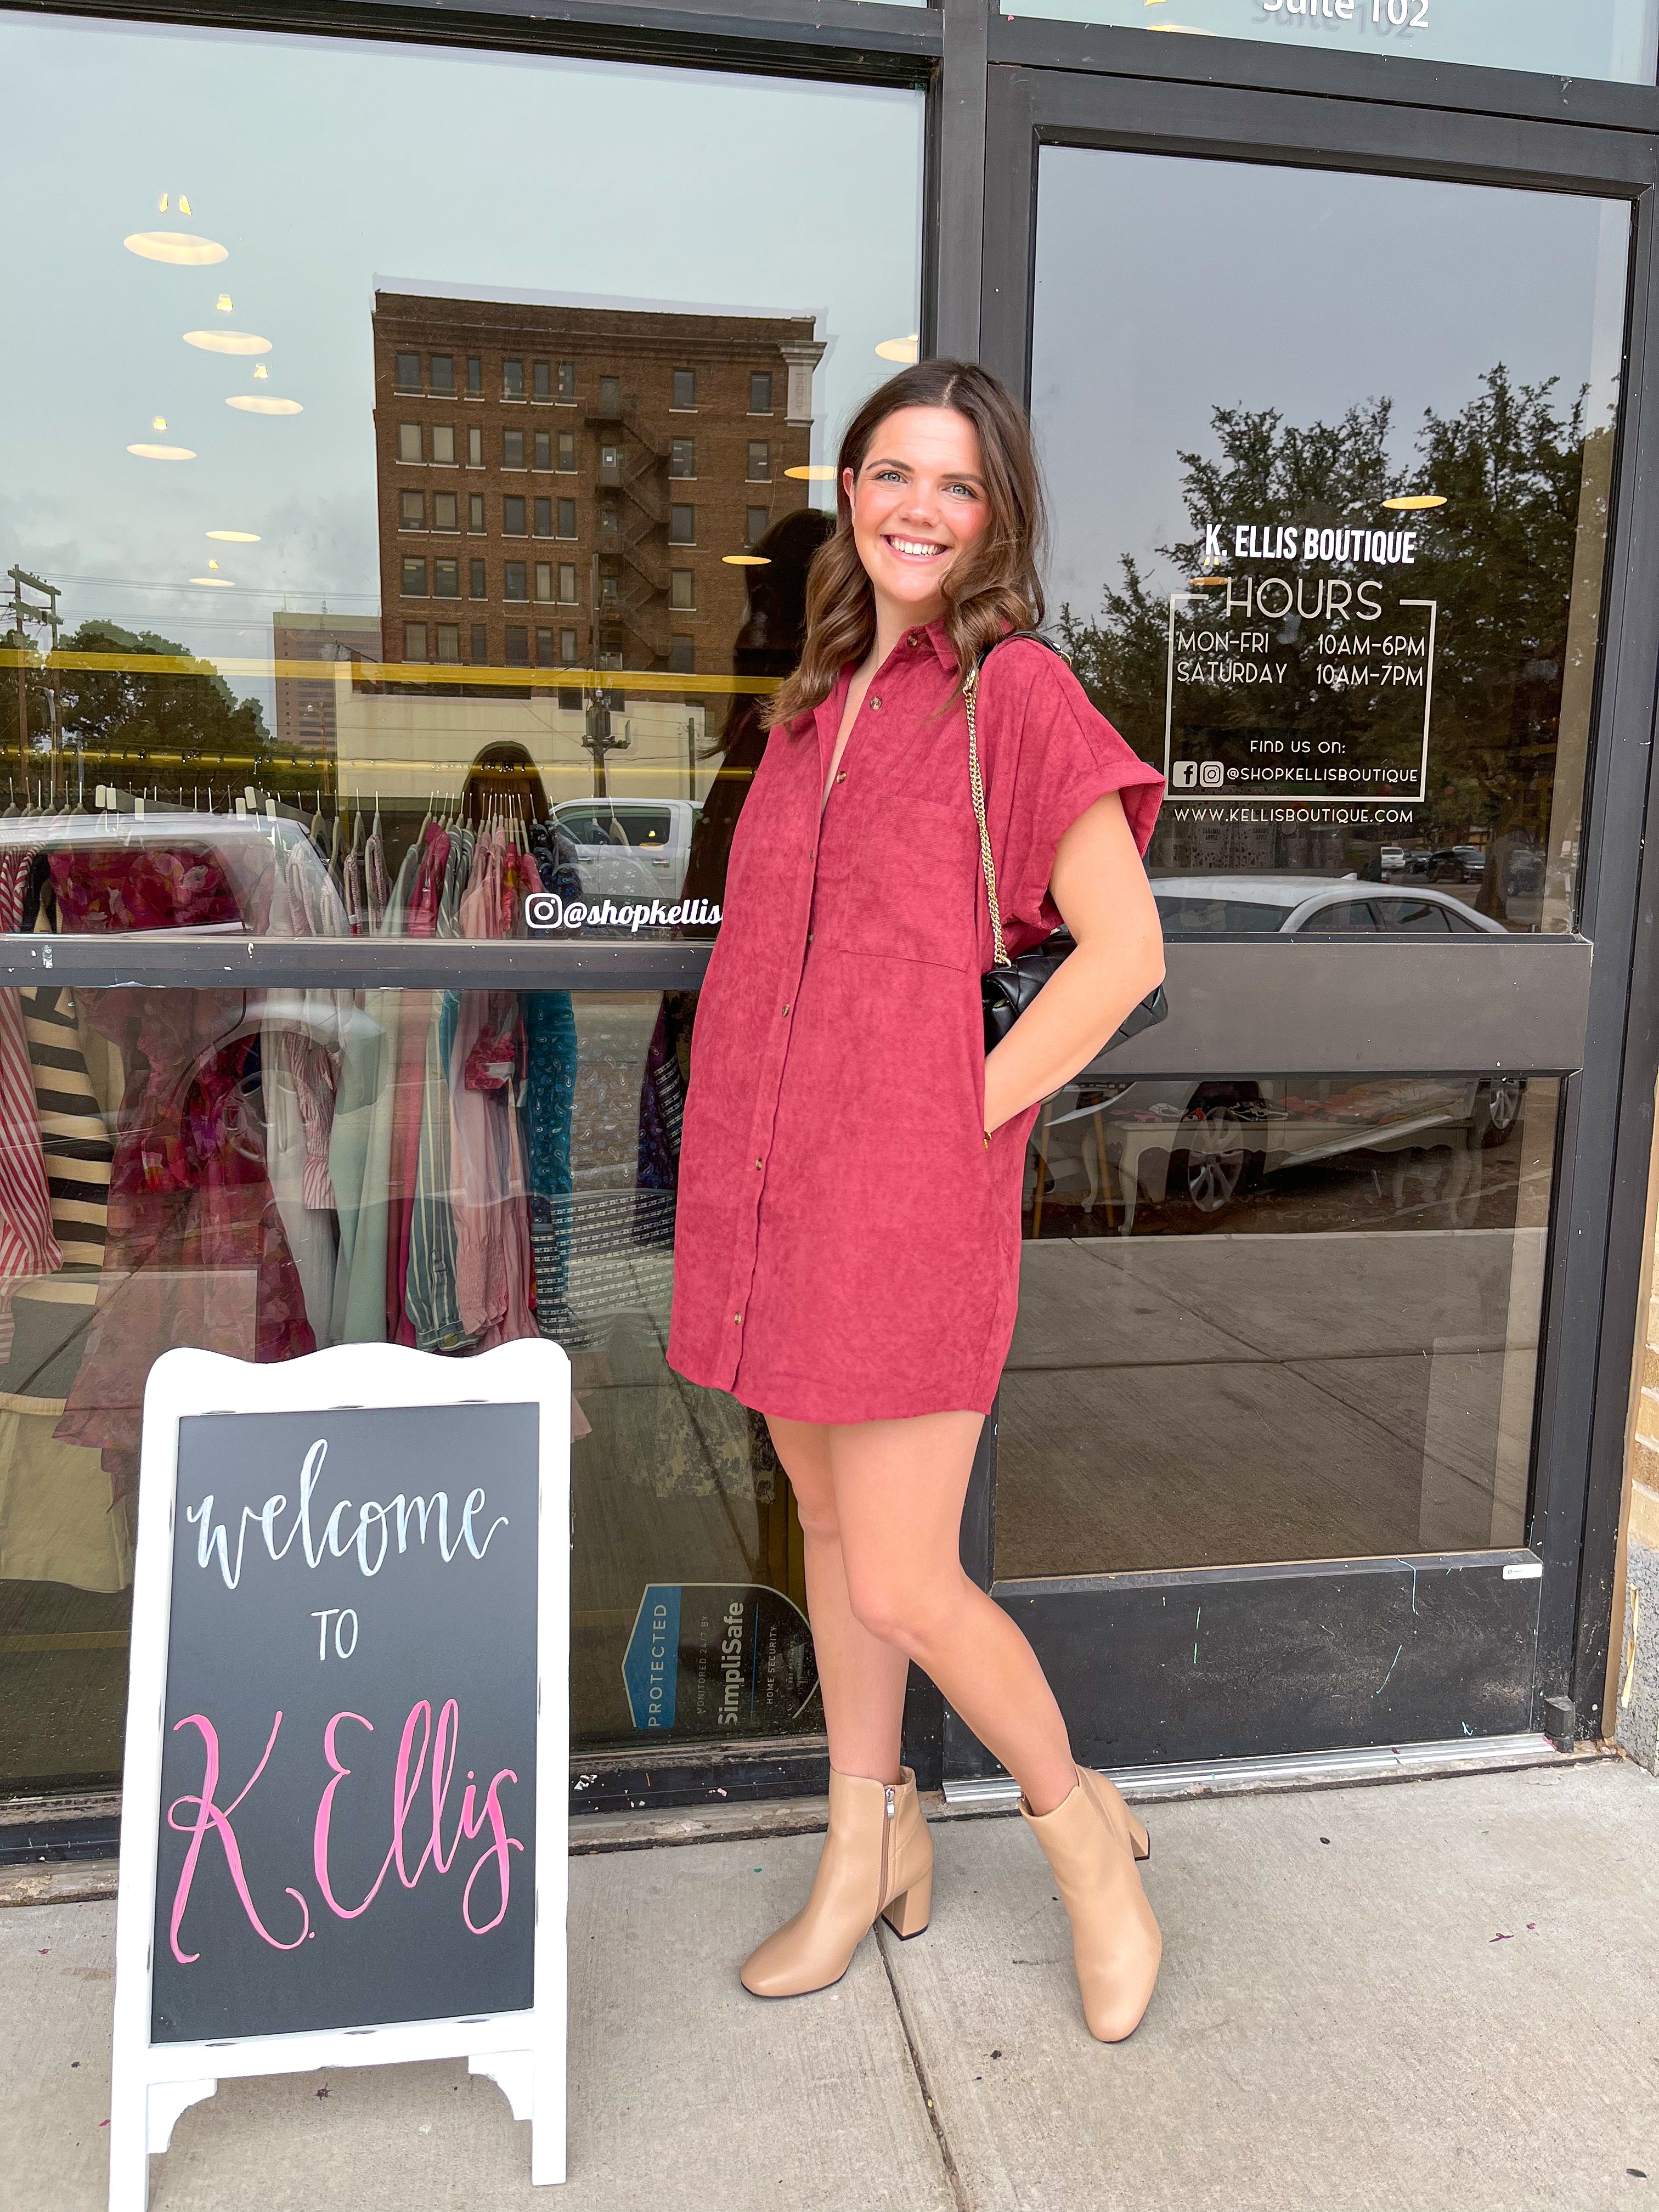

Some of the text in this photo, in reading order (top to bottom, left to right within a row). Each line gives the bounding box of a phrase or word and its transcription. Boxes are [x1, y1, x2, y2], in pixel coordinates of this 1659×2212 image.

[1372, 0, 1429, 27] 102
[1205, 523, 1417, 565] K. ELLIS BOUTIQUE
[1224, 577, 1383, 620] HOURS
[1178, 631, 1425, 657] MON-FRI 10AM-6PM
[1177, 661, 1423, 687] SATURDAY 10AM-7PM
[1291, 741, 1311, 753] US
[1227, 768, 1418, 783] @SHOPKELLISBOUTIQUE
[1174, 808, 1413, 823] WWW.KELLISBOUTIQUE.COM
[187, 1438, 509, 1590] welcome
[311, 1608, 358, 1661] TO
[768, 1626, 777, 1673] SECURITY
[648, 1604, 667, 1727] PROTECTED
[696, 1615, 709, 1715] MONITORED 24/7 BY
[718, 1602, 744, 1725] SimpliSafe
[313, 1698, 524, 1934] Ellis
